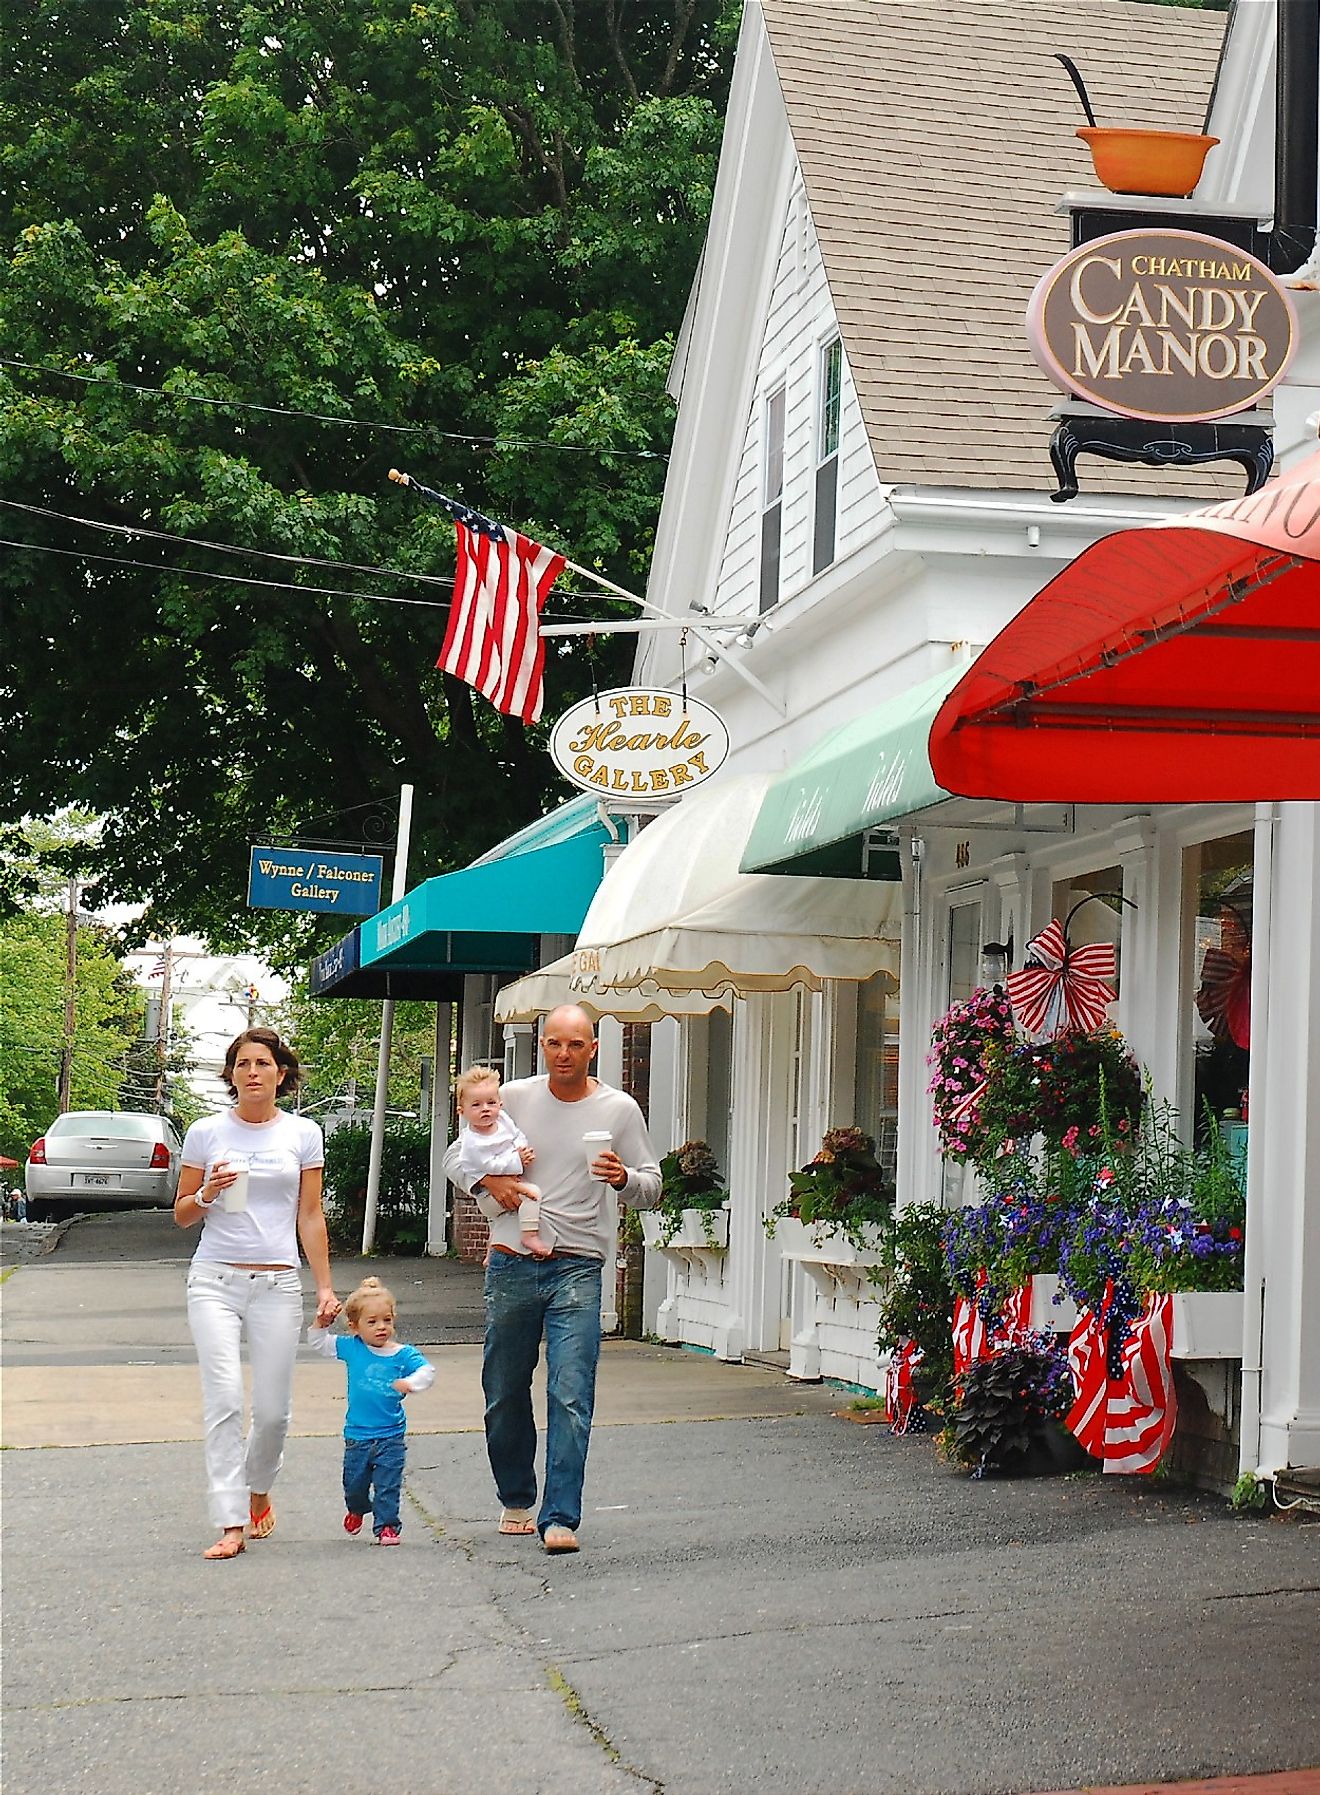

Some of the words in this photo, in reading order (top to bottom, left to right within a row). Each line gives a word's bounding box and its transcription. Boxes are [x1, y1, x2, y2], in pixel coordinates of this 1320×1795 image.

[1131, 255, 1252, 281] CHATHAM
[1070, 255, 1269, 334] CANDY
[1071, 322, 1270, 380] MANOR
[609, 695, 672, 718] THE
[569, 720, 711, 753] Hearle
[573, 751, 710, 791] GALLERY
[259, 860, 304, 879] Wynne
[317, 864, 375, 882] Falconer
[291, 883, 340, 903] Gallery
